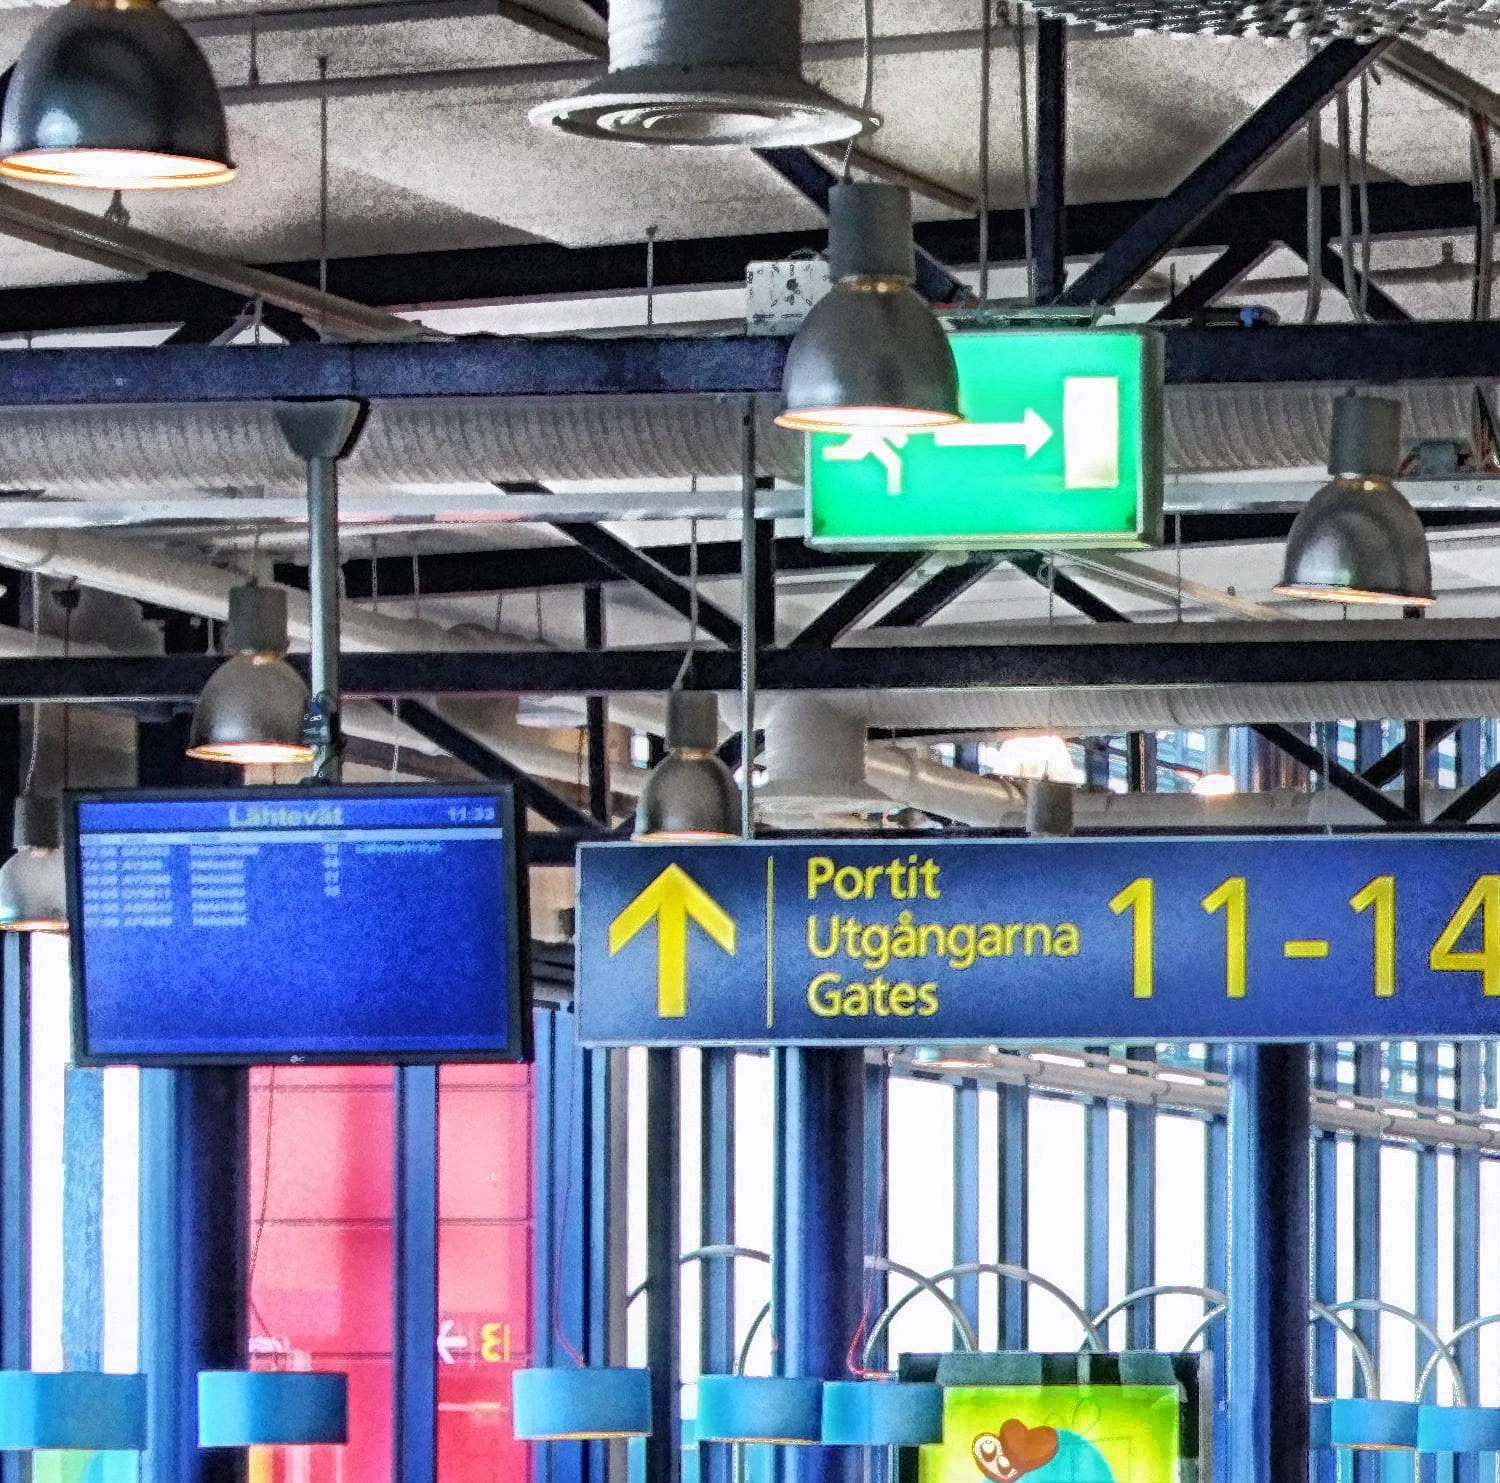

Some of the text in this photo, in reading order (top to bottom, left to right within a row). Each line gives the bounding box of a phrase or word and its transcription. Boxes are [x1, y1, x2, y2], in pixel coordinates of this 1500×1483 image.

[806, 855, 941, 900] Portit
[807, 911, 1080, 970] Utgångarna
[807, 970, 939, 1018] Gates
